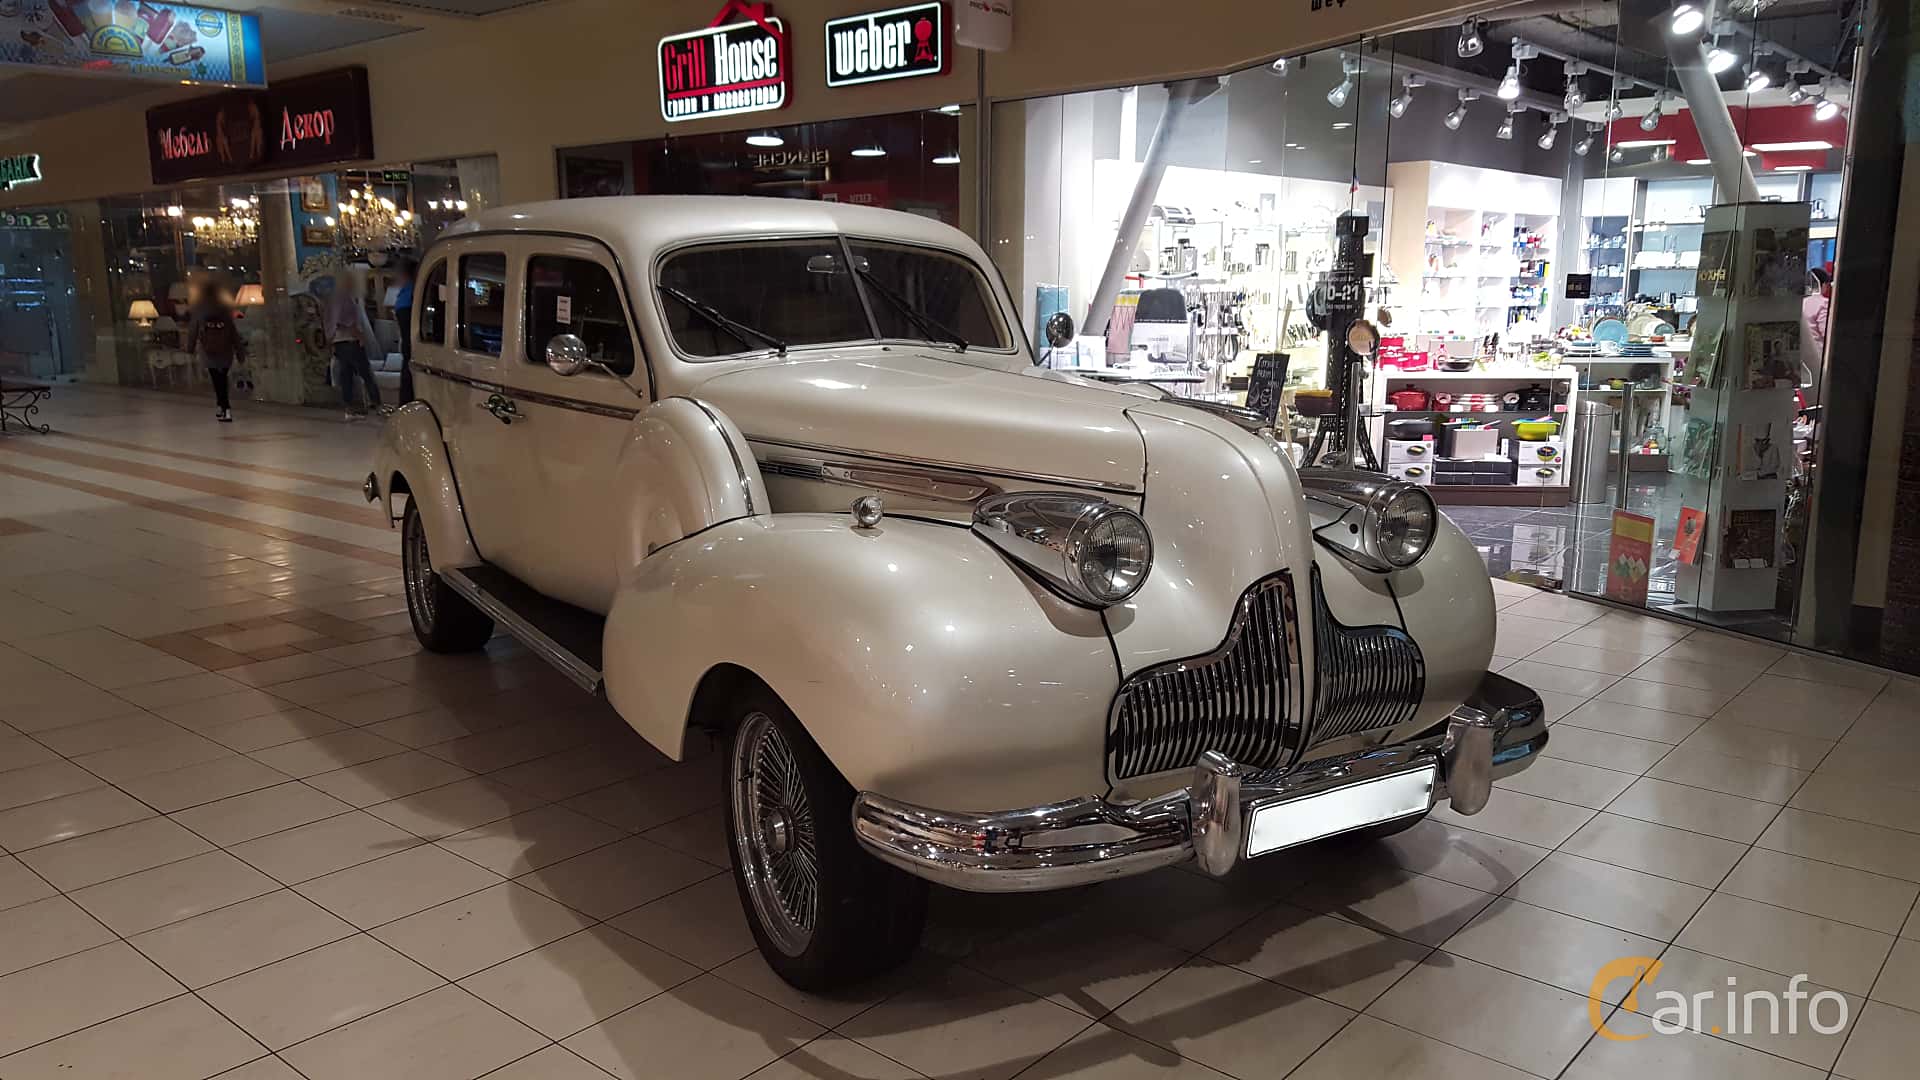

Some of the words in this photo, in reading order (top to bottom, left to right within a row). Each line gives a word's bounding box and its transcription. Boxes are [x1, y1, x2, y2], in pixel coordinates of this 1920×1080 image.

[664, 38, 707, 91] Grill
[713, 33, 777, 86] House
[833, 16, 911, 76] weber
[160, 127, 210, 160] Мебель
[280, 105, 335, 151] Декор
